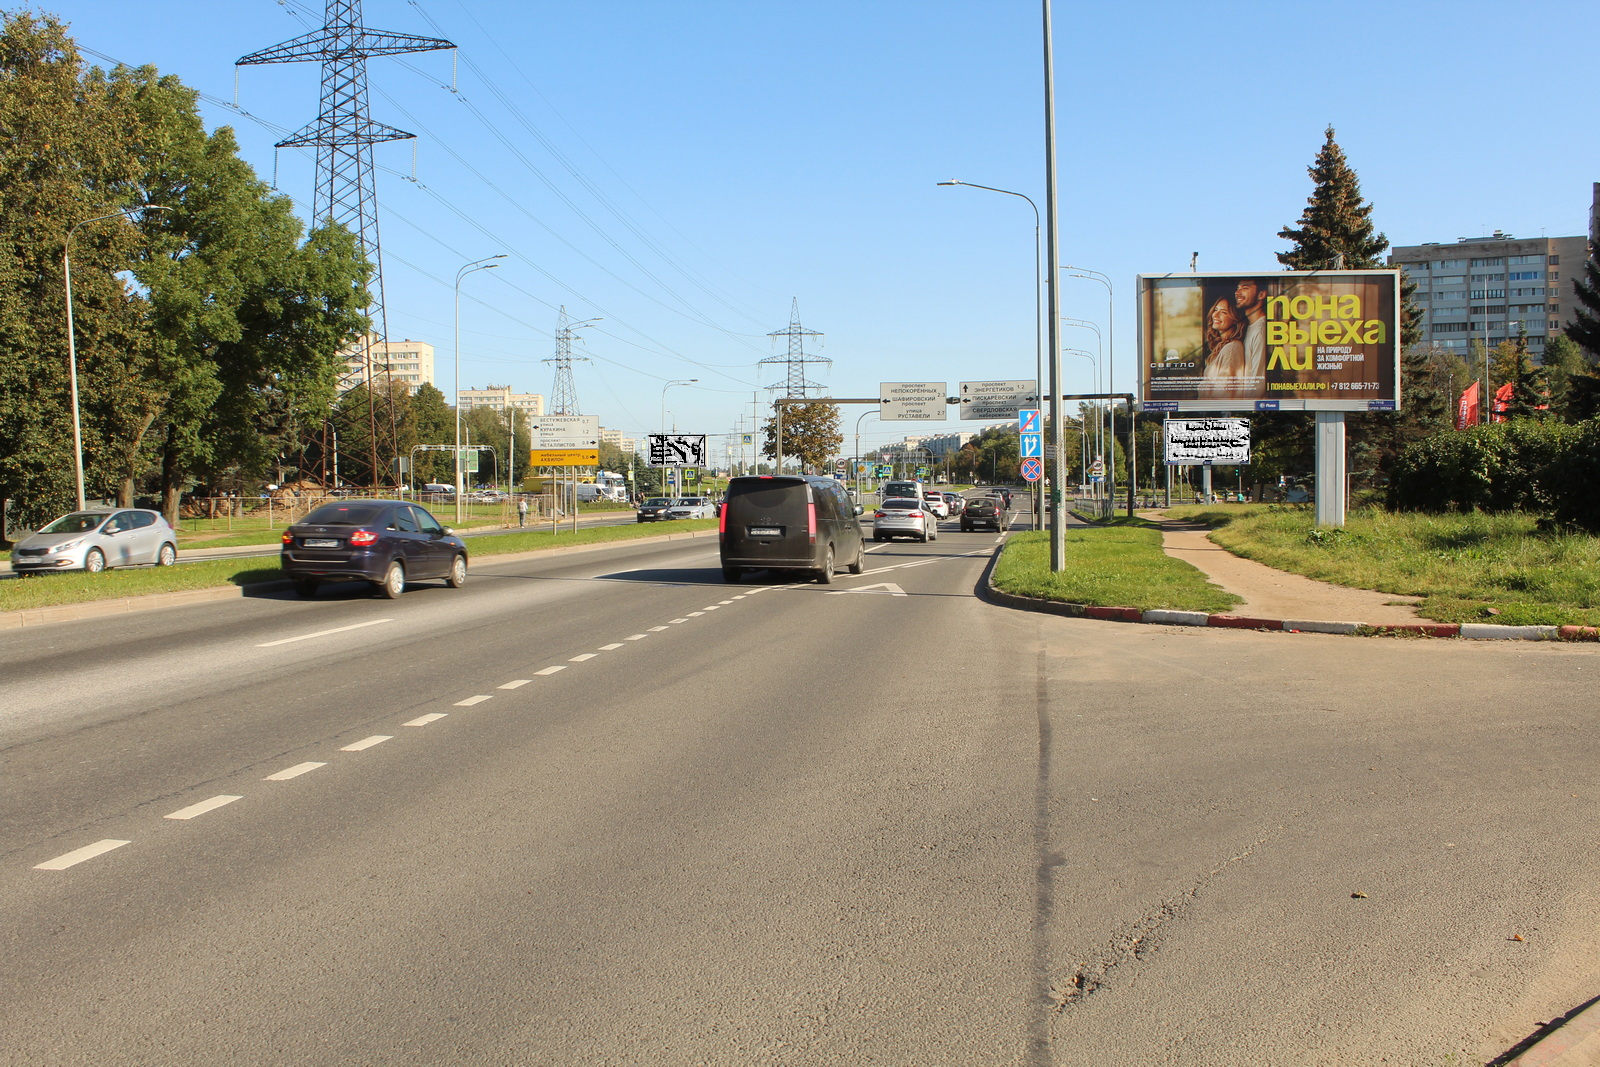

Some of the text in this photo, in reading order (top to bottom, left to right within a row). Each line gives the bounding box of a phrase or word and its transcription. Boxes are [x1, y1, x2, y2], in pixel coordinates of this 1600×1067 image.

[1326, 346, 1352, 354] ПРИРОДУ
[1326, 353, 1364, 362] КОМФОРТНОЙ
[1270, 382, 1326, 391] ПОНАВЫЕХАЛИ.РФ
[1350, 382, 1380, 390] 665-71-73
